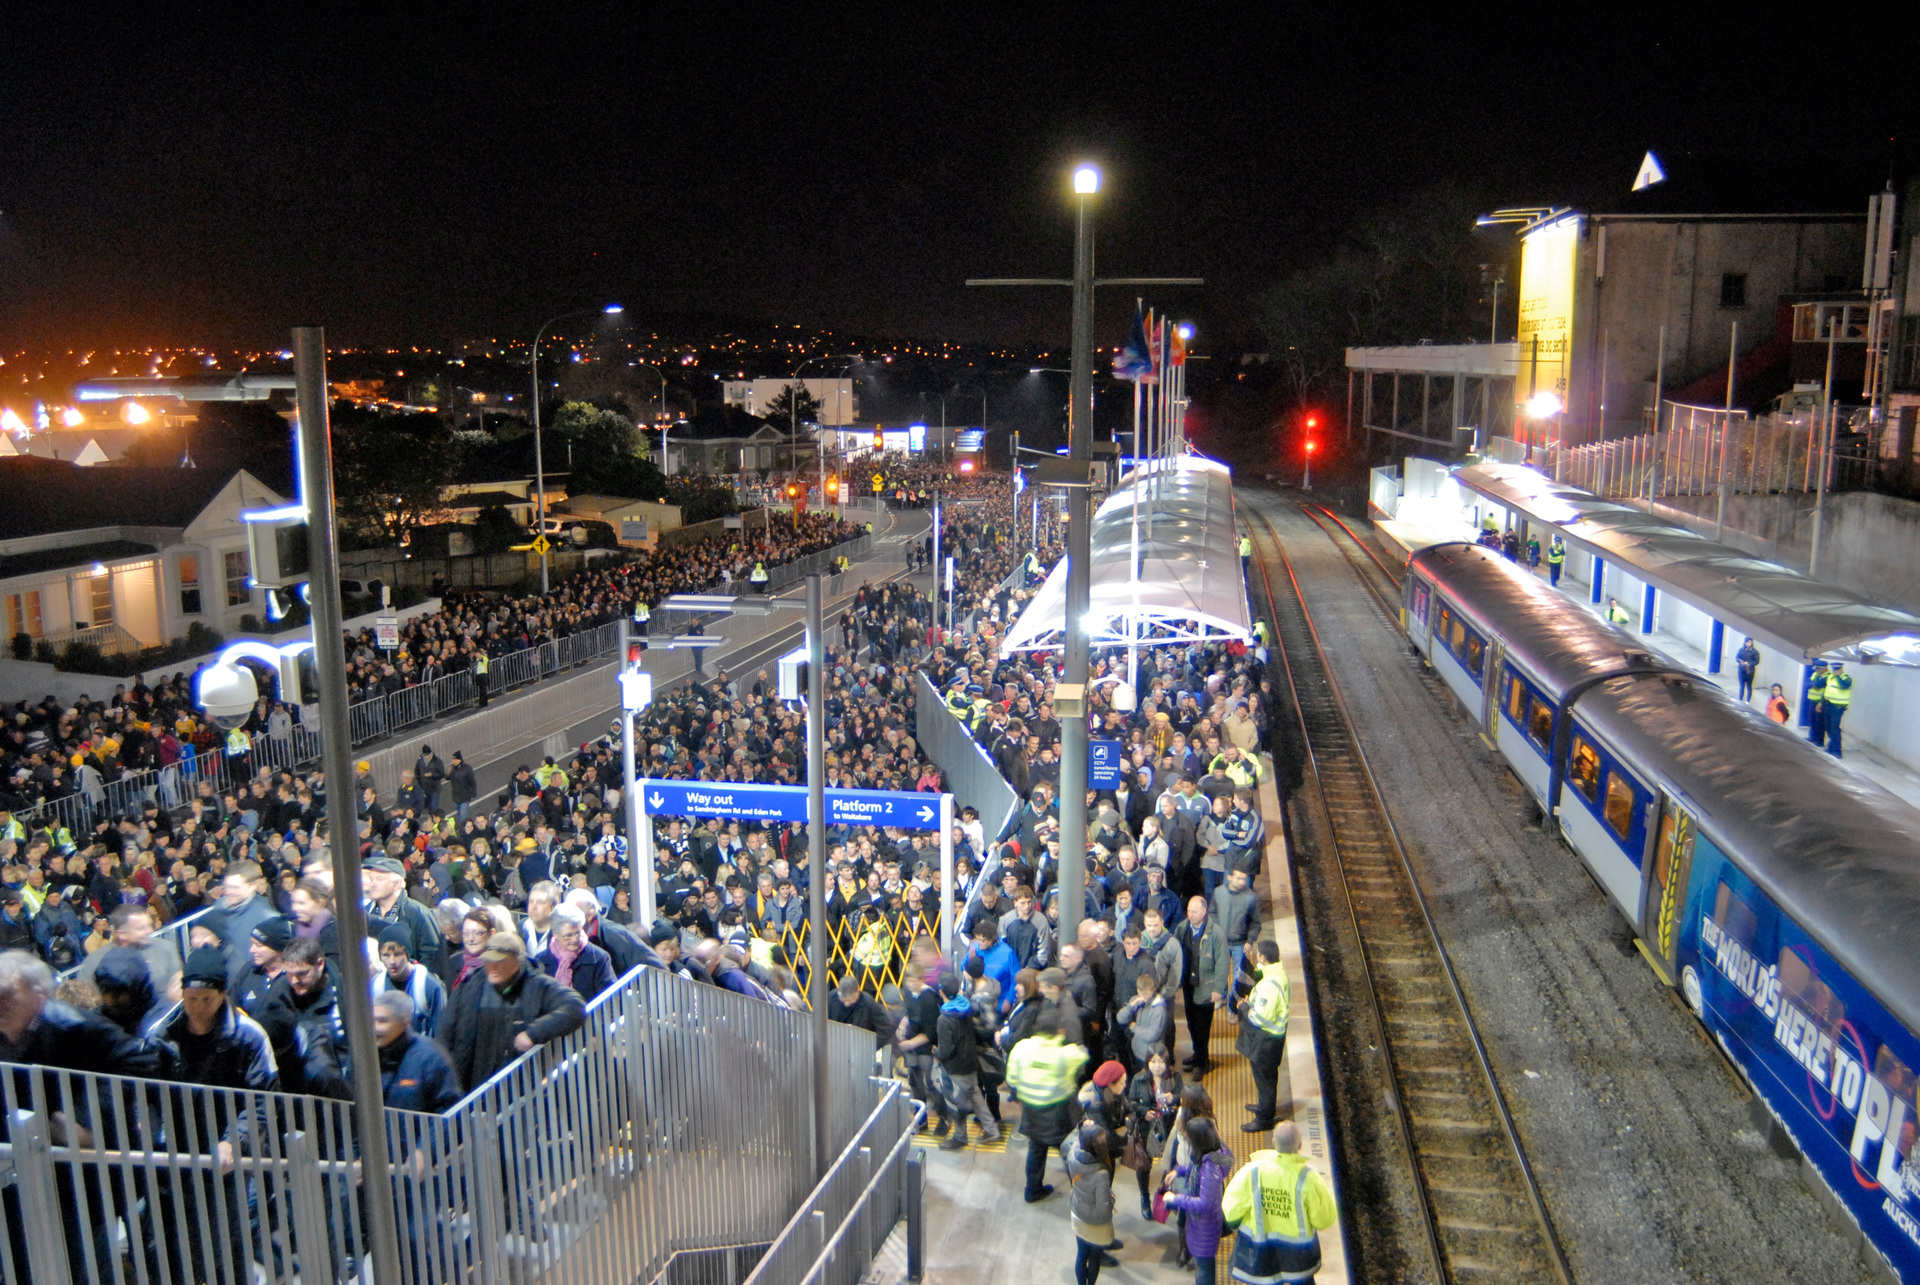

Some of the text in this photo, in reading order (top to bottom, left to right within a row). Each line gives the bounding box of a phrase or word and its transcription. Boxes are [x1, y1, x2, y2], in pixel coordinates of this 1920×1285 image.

[686, 792, 733, 806] Way out
[694, 805, 732, 815] Sandringham
[754, 808, 769, 816] Eden
[769, 809, 783, 817] Park
[832, 799, 893, 813] Platform 2
[841, 813, 872, 821] Waitakere
[1702, 915, 1720, 948] THE
[1715, 929, 1782, 1019] WORLD'S
[1773, 997, 1833, 1084] HERE
[1830, 1045, 1863, 1111] TO
[1306, 1107, 1324, 1158] MIND THE GAP
[1260, 1186, 1291, 1198] SPECIAL
[1261, 1194, 1292, 1205] EVENTS
[1261, 1201, 1292, 1212] VEOLIA
[1264, 1208, 1291, 1219] TEAM
